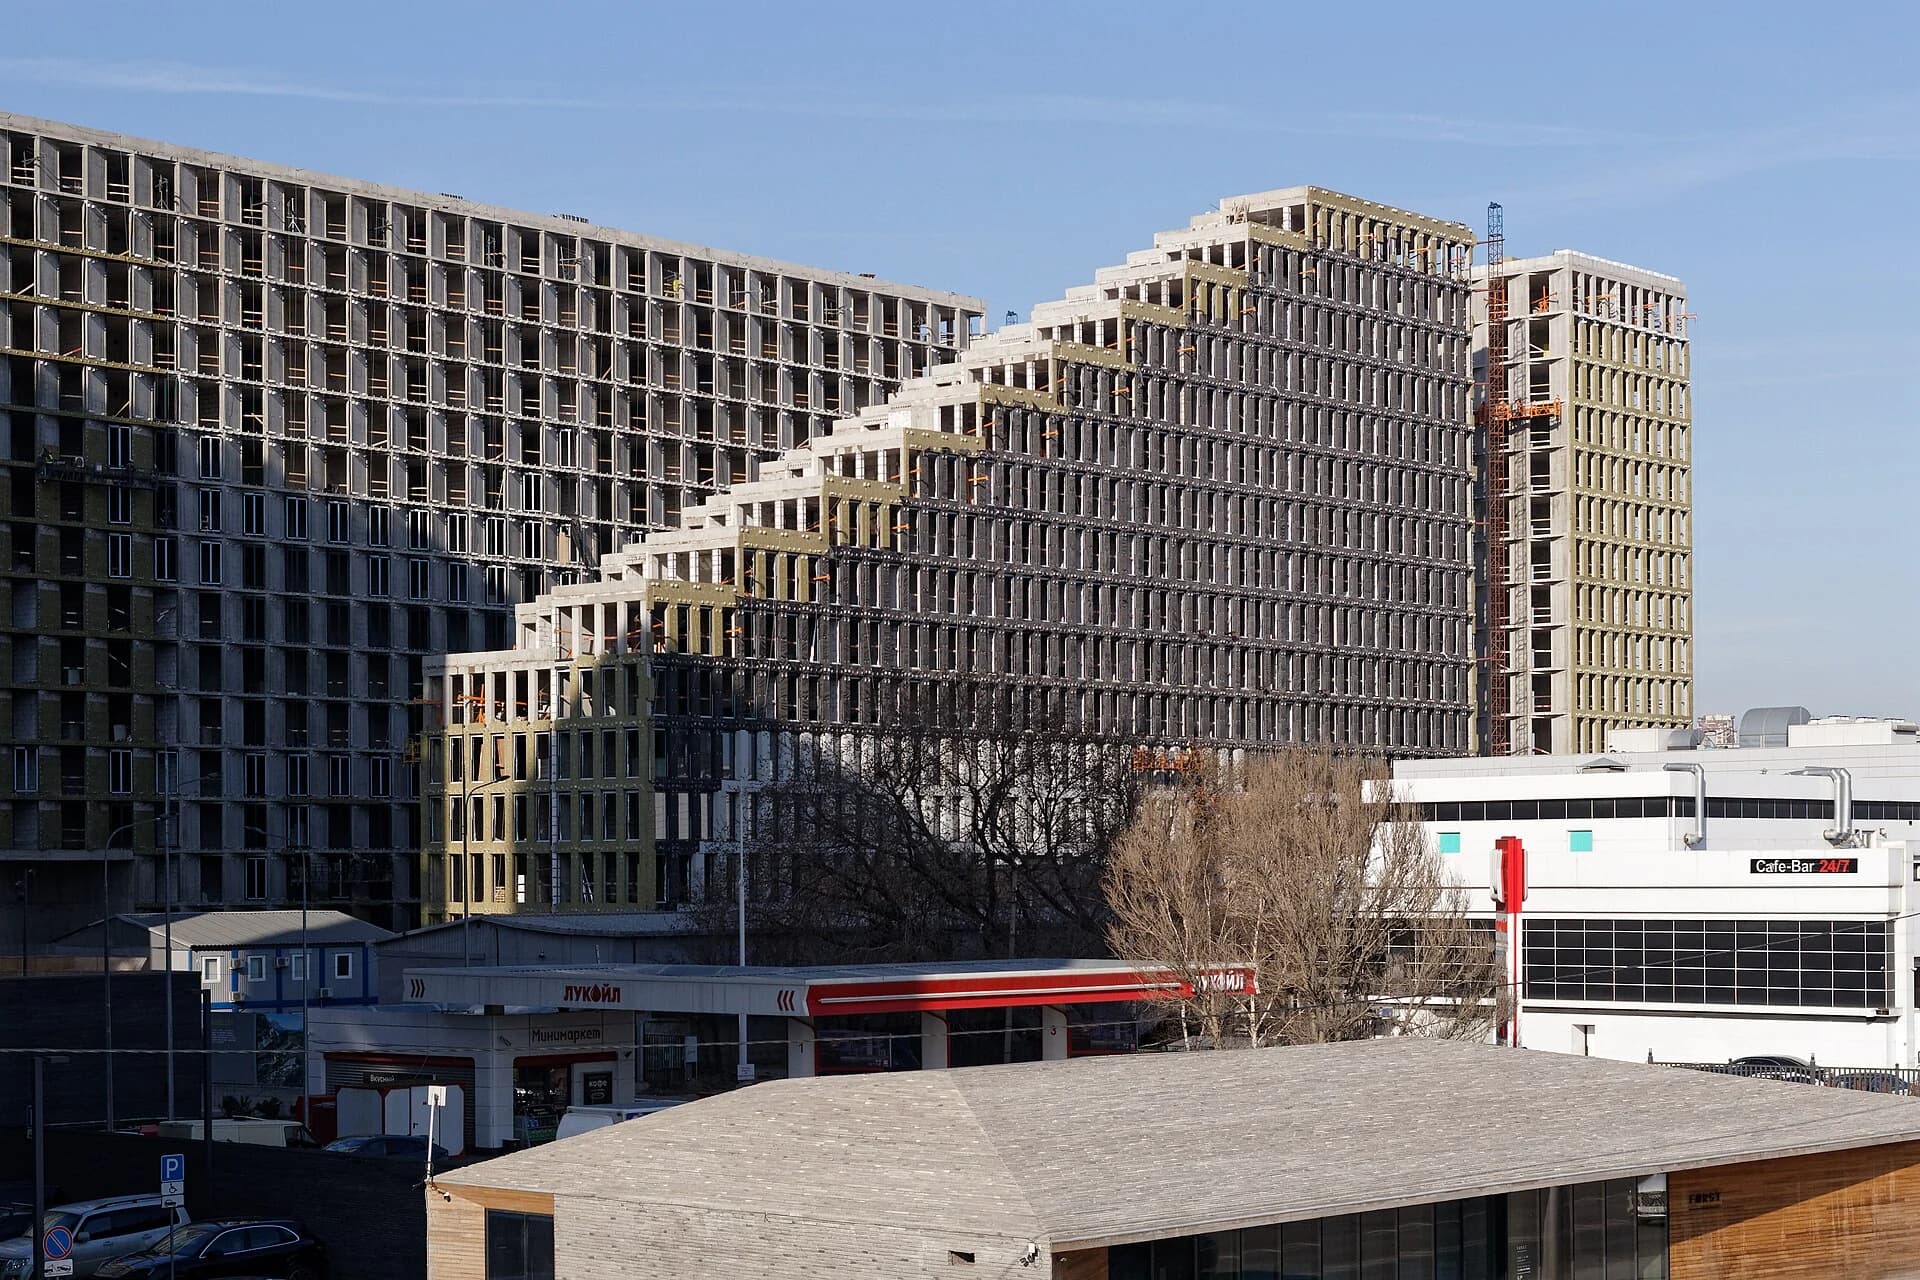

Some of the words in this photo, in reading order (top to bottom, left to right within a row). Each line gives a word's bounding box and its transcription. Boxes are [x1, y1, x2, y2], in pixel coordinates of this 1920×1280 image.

[1755, 859, 1815, 873] Cafe-Bar
[1819, 859, 1850, 873] 24/7
[563, 983, 621, 1003] ЛУКОЙЛ
[531, 1029, 601, 1043] Минимаркет
[166, 1158, 179, 1179] P
